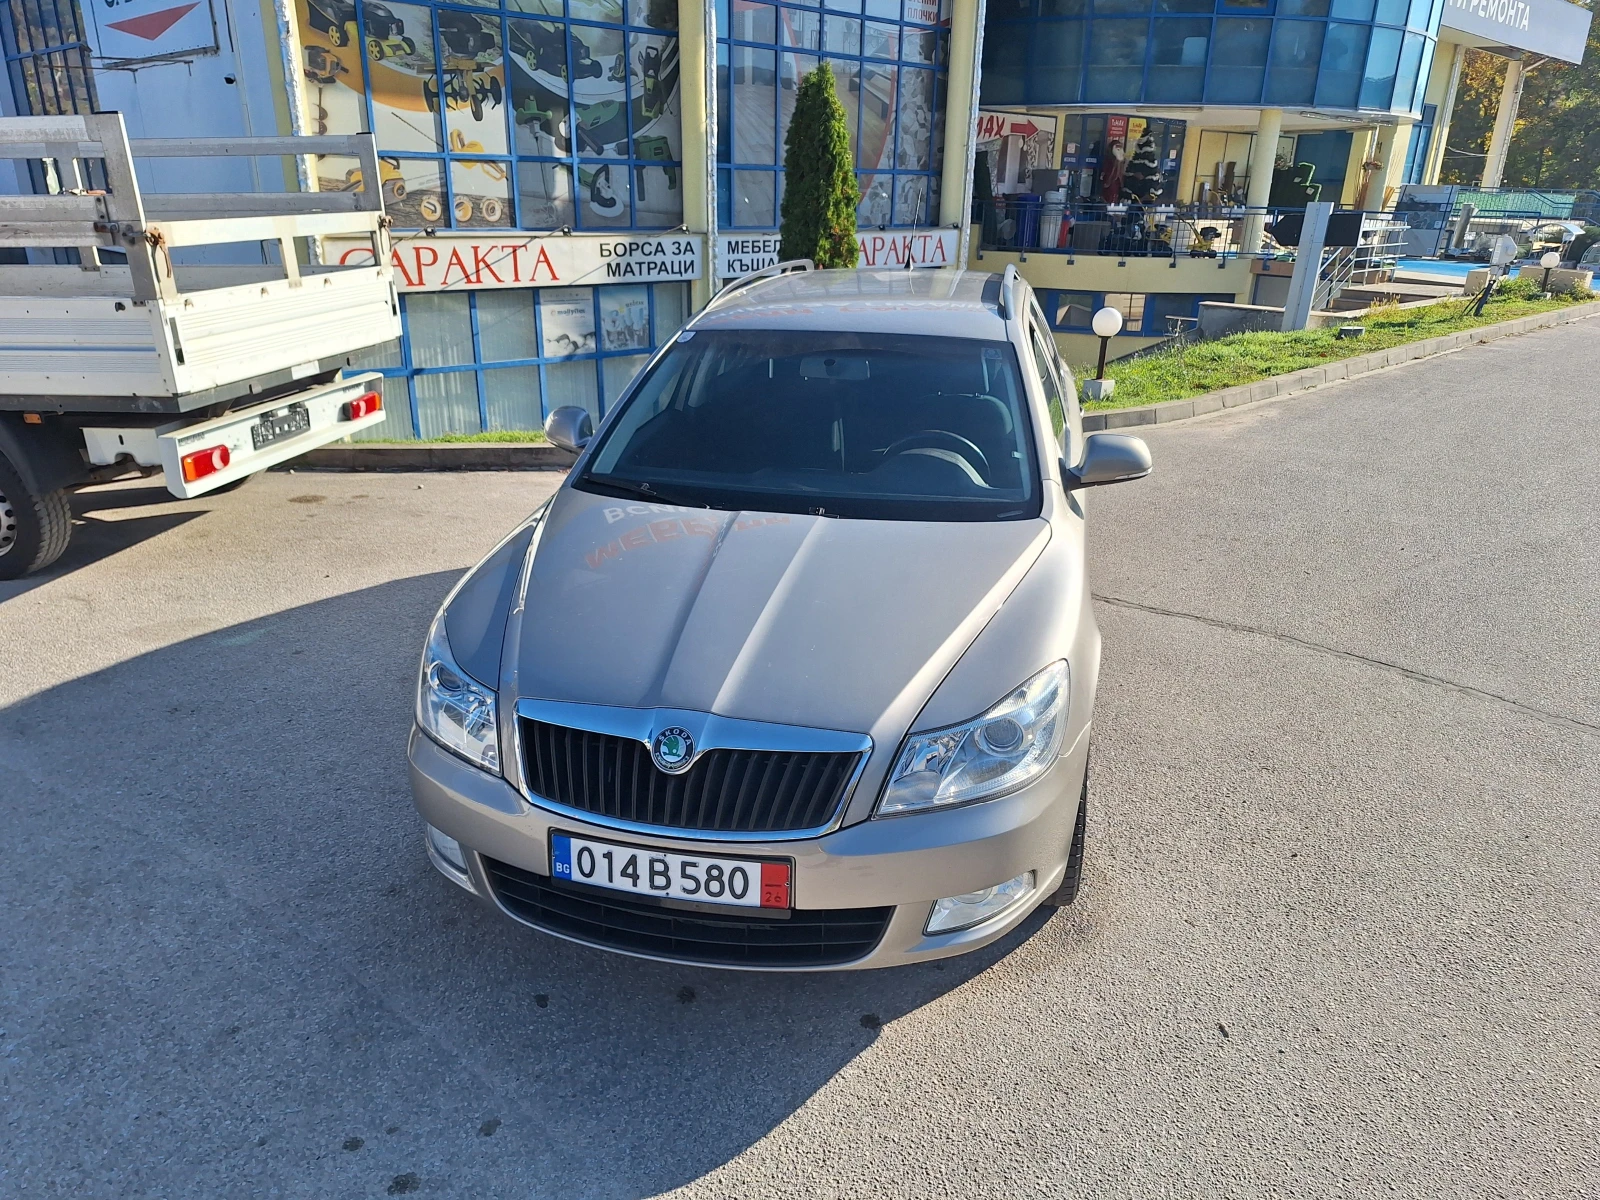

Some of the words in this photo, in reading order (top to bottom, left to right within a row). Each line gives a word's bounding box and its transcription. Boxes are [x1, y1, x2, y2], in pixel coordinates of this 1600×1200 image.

[1469, 0, 1530, 31] РЕМОНТА
[600, 241, 666, 258] БОРСА
[672, 241, 695, 256] ЗА
[727, 239, 782, 255] МЕБЕЛ
[858, 234, 947, 267] АРАКТА
[607, 259, 695, 277] МАТРАЦИ
[556, 862, 570, 874] BG
[765, 891, 782, 903] 26
